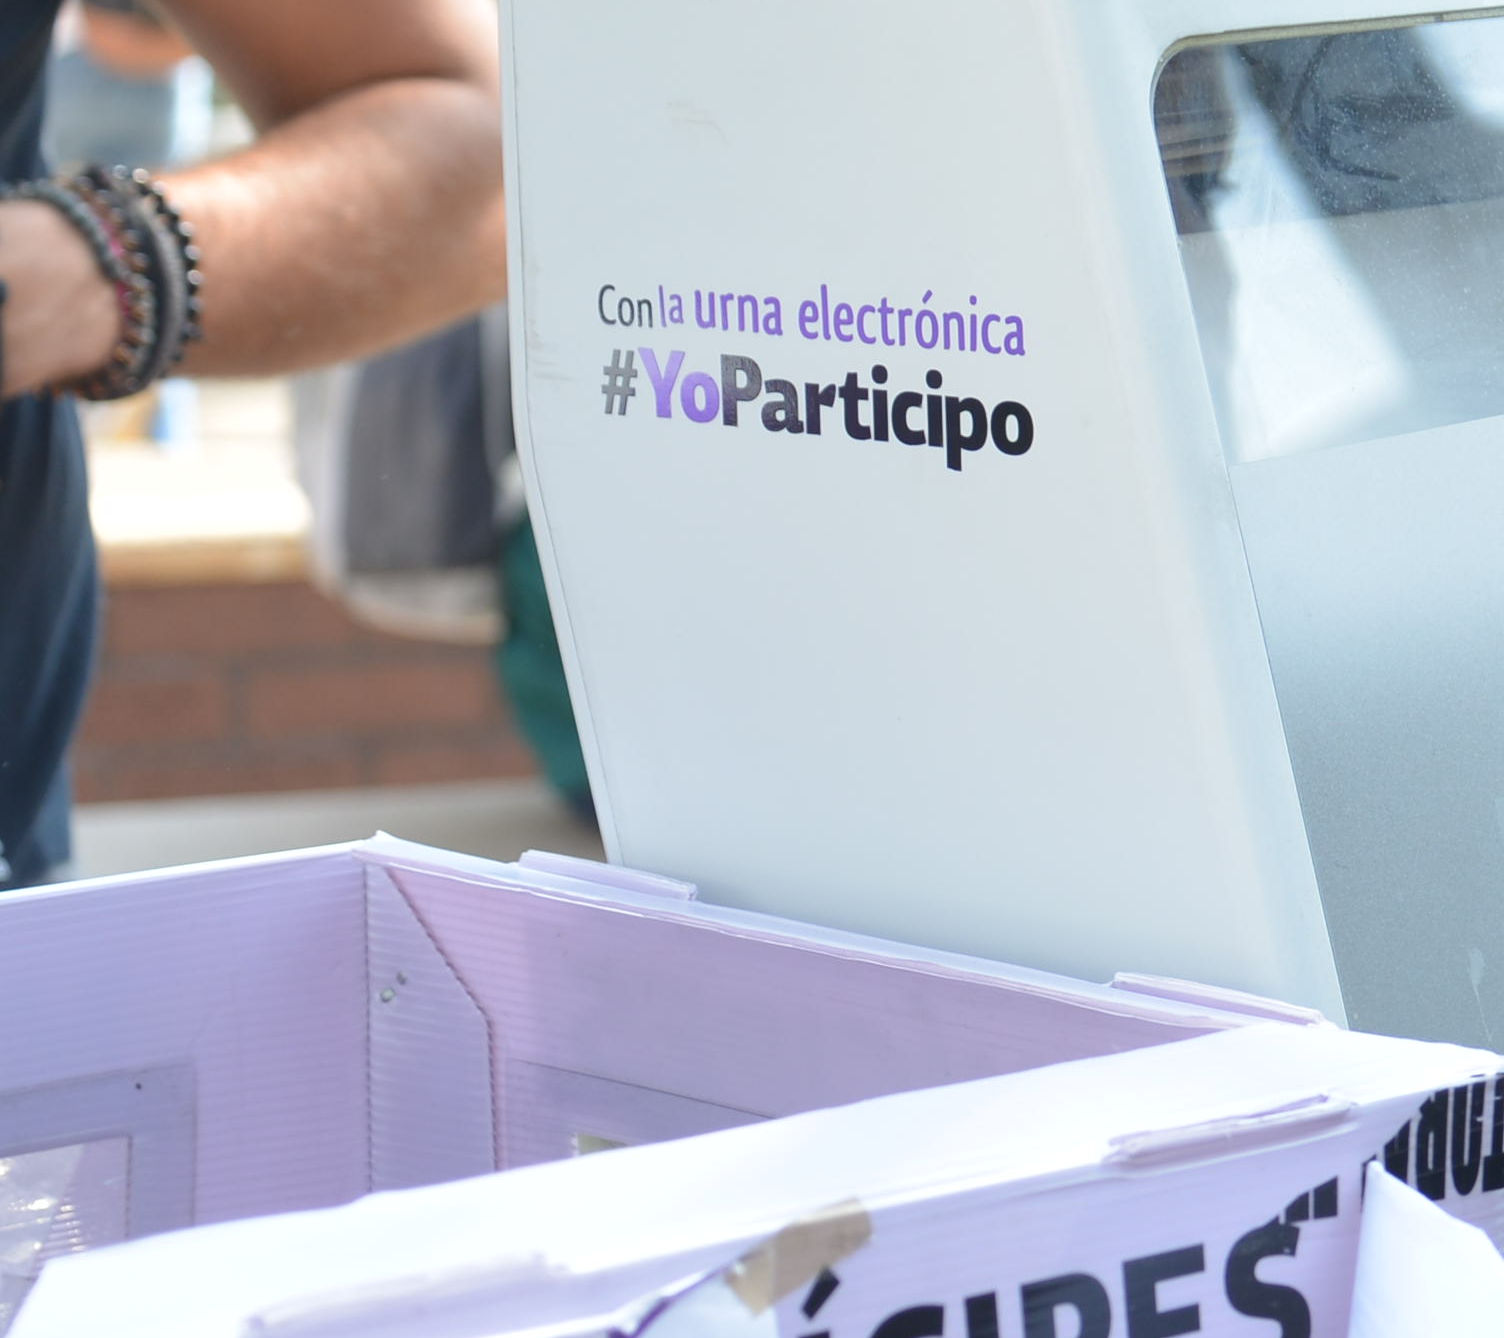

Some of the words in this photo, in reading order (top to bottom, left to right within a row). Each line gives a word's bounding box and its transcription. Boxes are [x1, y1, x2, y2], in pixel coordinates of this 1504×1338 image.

[694, 289, 783, 336] urna
[798, 283, 1026, 356] electrónica
[601, 346, 1035, 472] #YoParticipo
